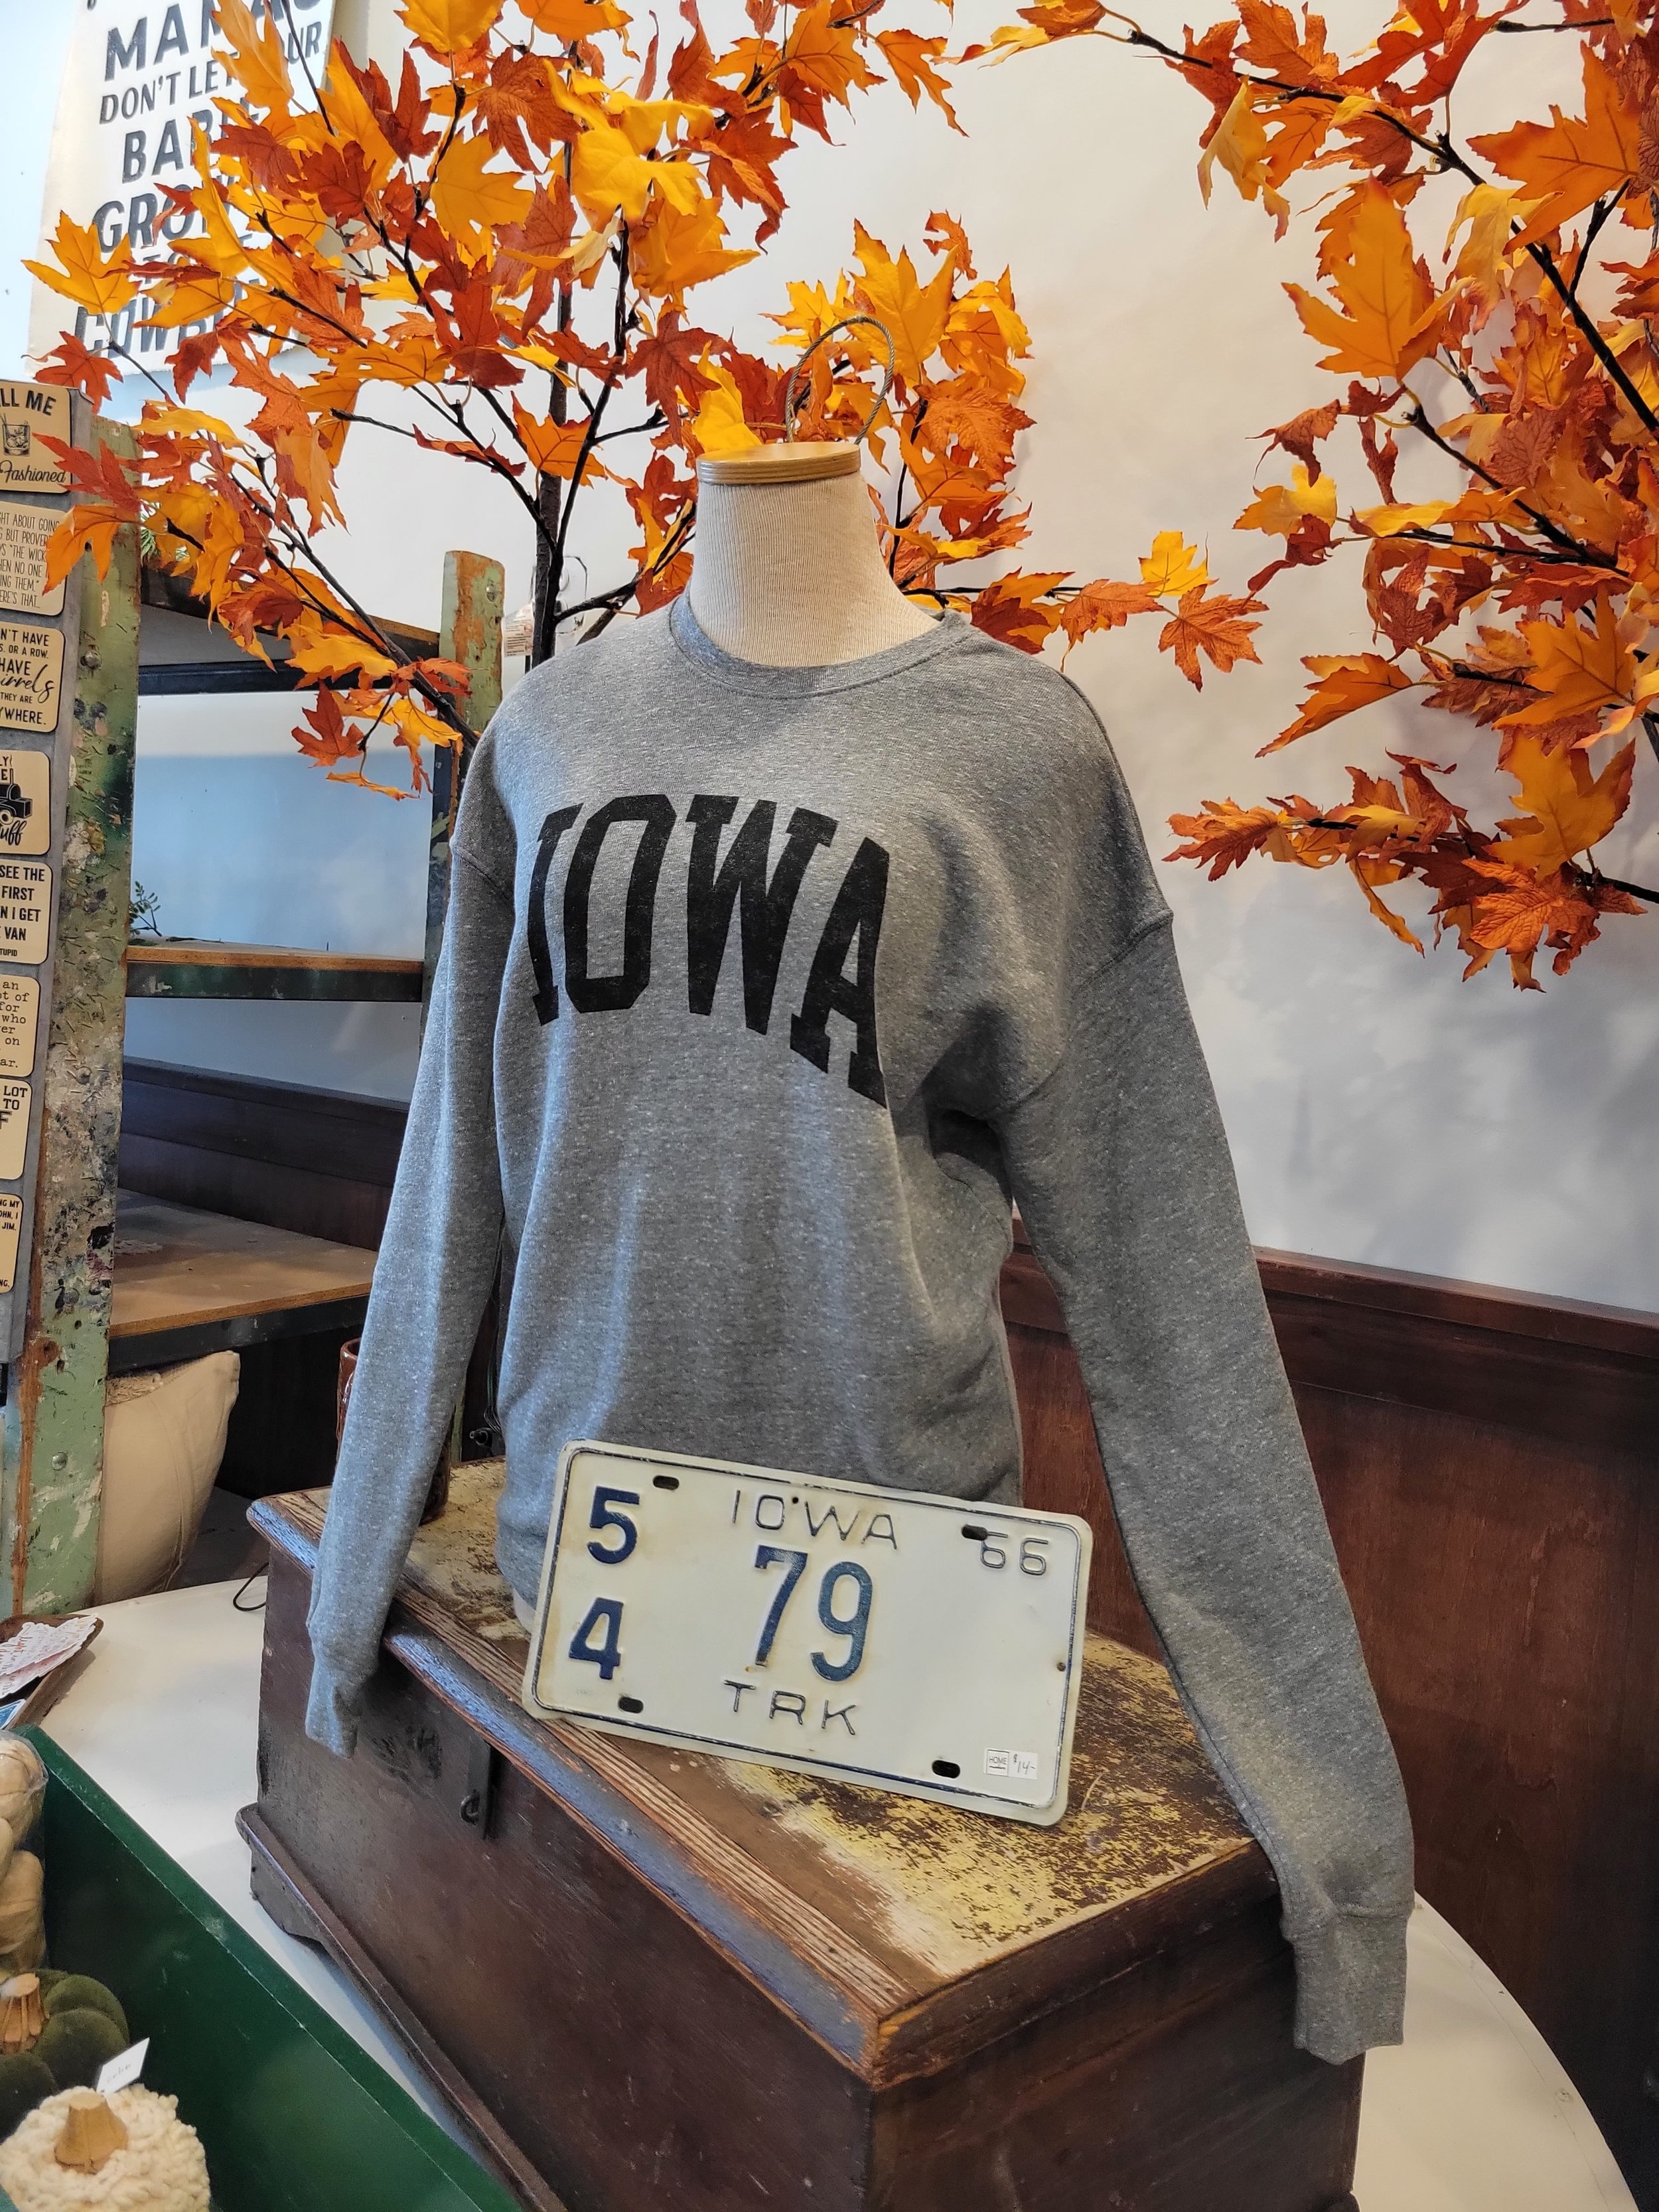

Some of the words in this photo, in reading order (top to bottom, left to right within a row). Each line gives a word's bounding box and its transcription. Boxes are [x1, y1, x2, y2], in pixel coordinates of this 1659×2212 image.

[100, 72, 181, 125] DON'T
[0, 388, 20, 407] LL
[25, 390, 56, 416] ME
[0, 460, 66, 483] Fashioned
[13, 514, 36, 530] ABOUT
[6, 528, 19, 542] BUT
[29, 548, 46, 562] WICK
[15, 561, 25, 575] NO
[28, 563, 43, 577] ONE
[23, 631, 50, 646] HAVE
[9, 644, 19, 654] OR
[22, 647, 27, 656] A
[30, 648, 48, 659] ROW.
[0, 657, 31, 676] HAVE
[0, 692, 17, 701] THEY
[19, 696, 33, 704] ARE
[0, 820, 27, 846] uff
[0, 865, 20, 879] SEE
[23, 867, 45, 882] THE
[1, 885, 35, 901] FIRST
[0, 906, 8, 919] N
[12, 907, 15, 920] I
[19, 908, 41, 922] GET
[5, 926, 27, 941] VAN
[528, 794, 890, 1108] IOWA
[3, 982, 19, 990] an
[15, 992, 30, 1002] of
[0, 1001, 20, 1012] for
[1, 1013, 27, 1024] who
[0, 1025, 16, 1034] er
[5, 1037, 20, 1046] on
[3, 1085, 29, 1098] LOT
[3, 1098, 20, 1110] TO
[9, 1200, 20, 1209] MY
[2, 1222, 17, 1230] JIM.
[587, 1485, 640, 1564] 5
[733, 1490, 897, 1550] IOWA
[979, 1530, 1049, 1576] 66
[754, 1544, 873, 1681] 79
[568, 1597, 624, 1680] 4
[723, 1679, 857, 1735] TRK
[989, 1757, 1007, 1765] HOME
